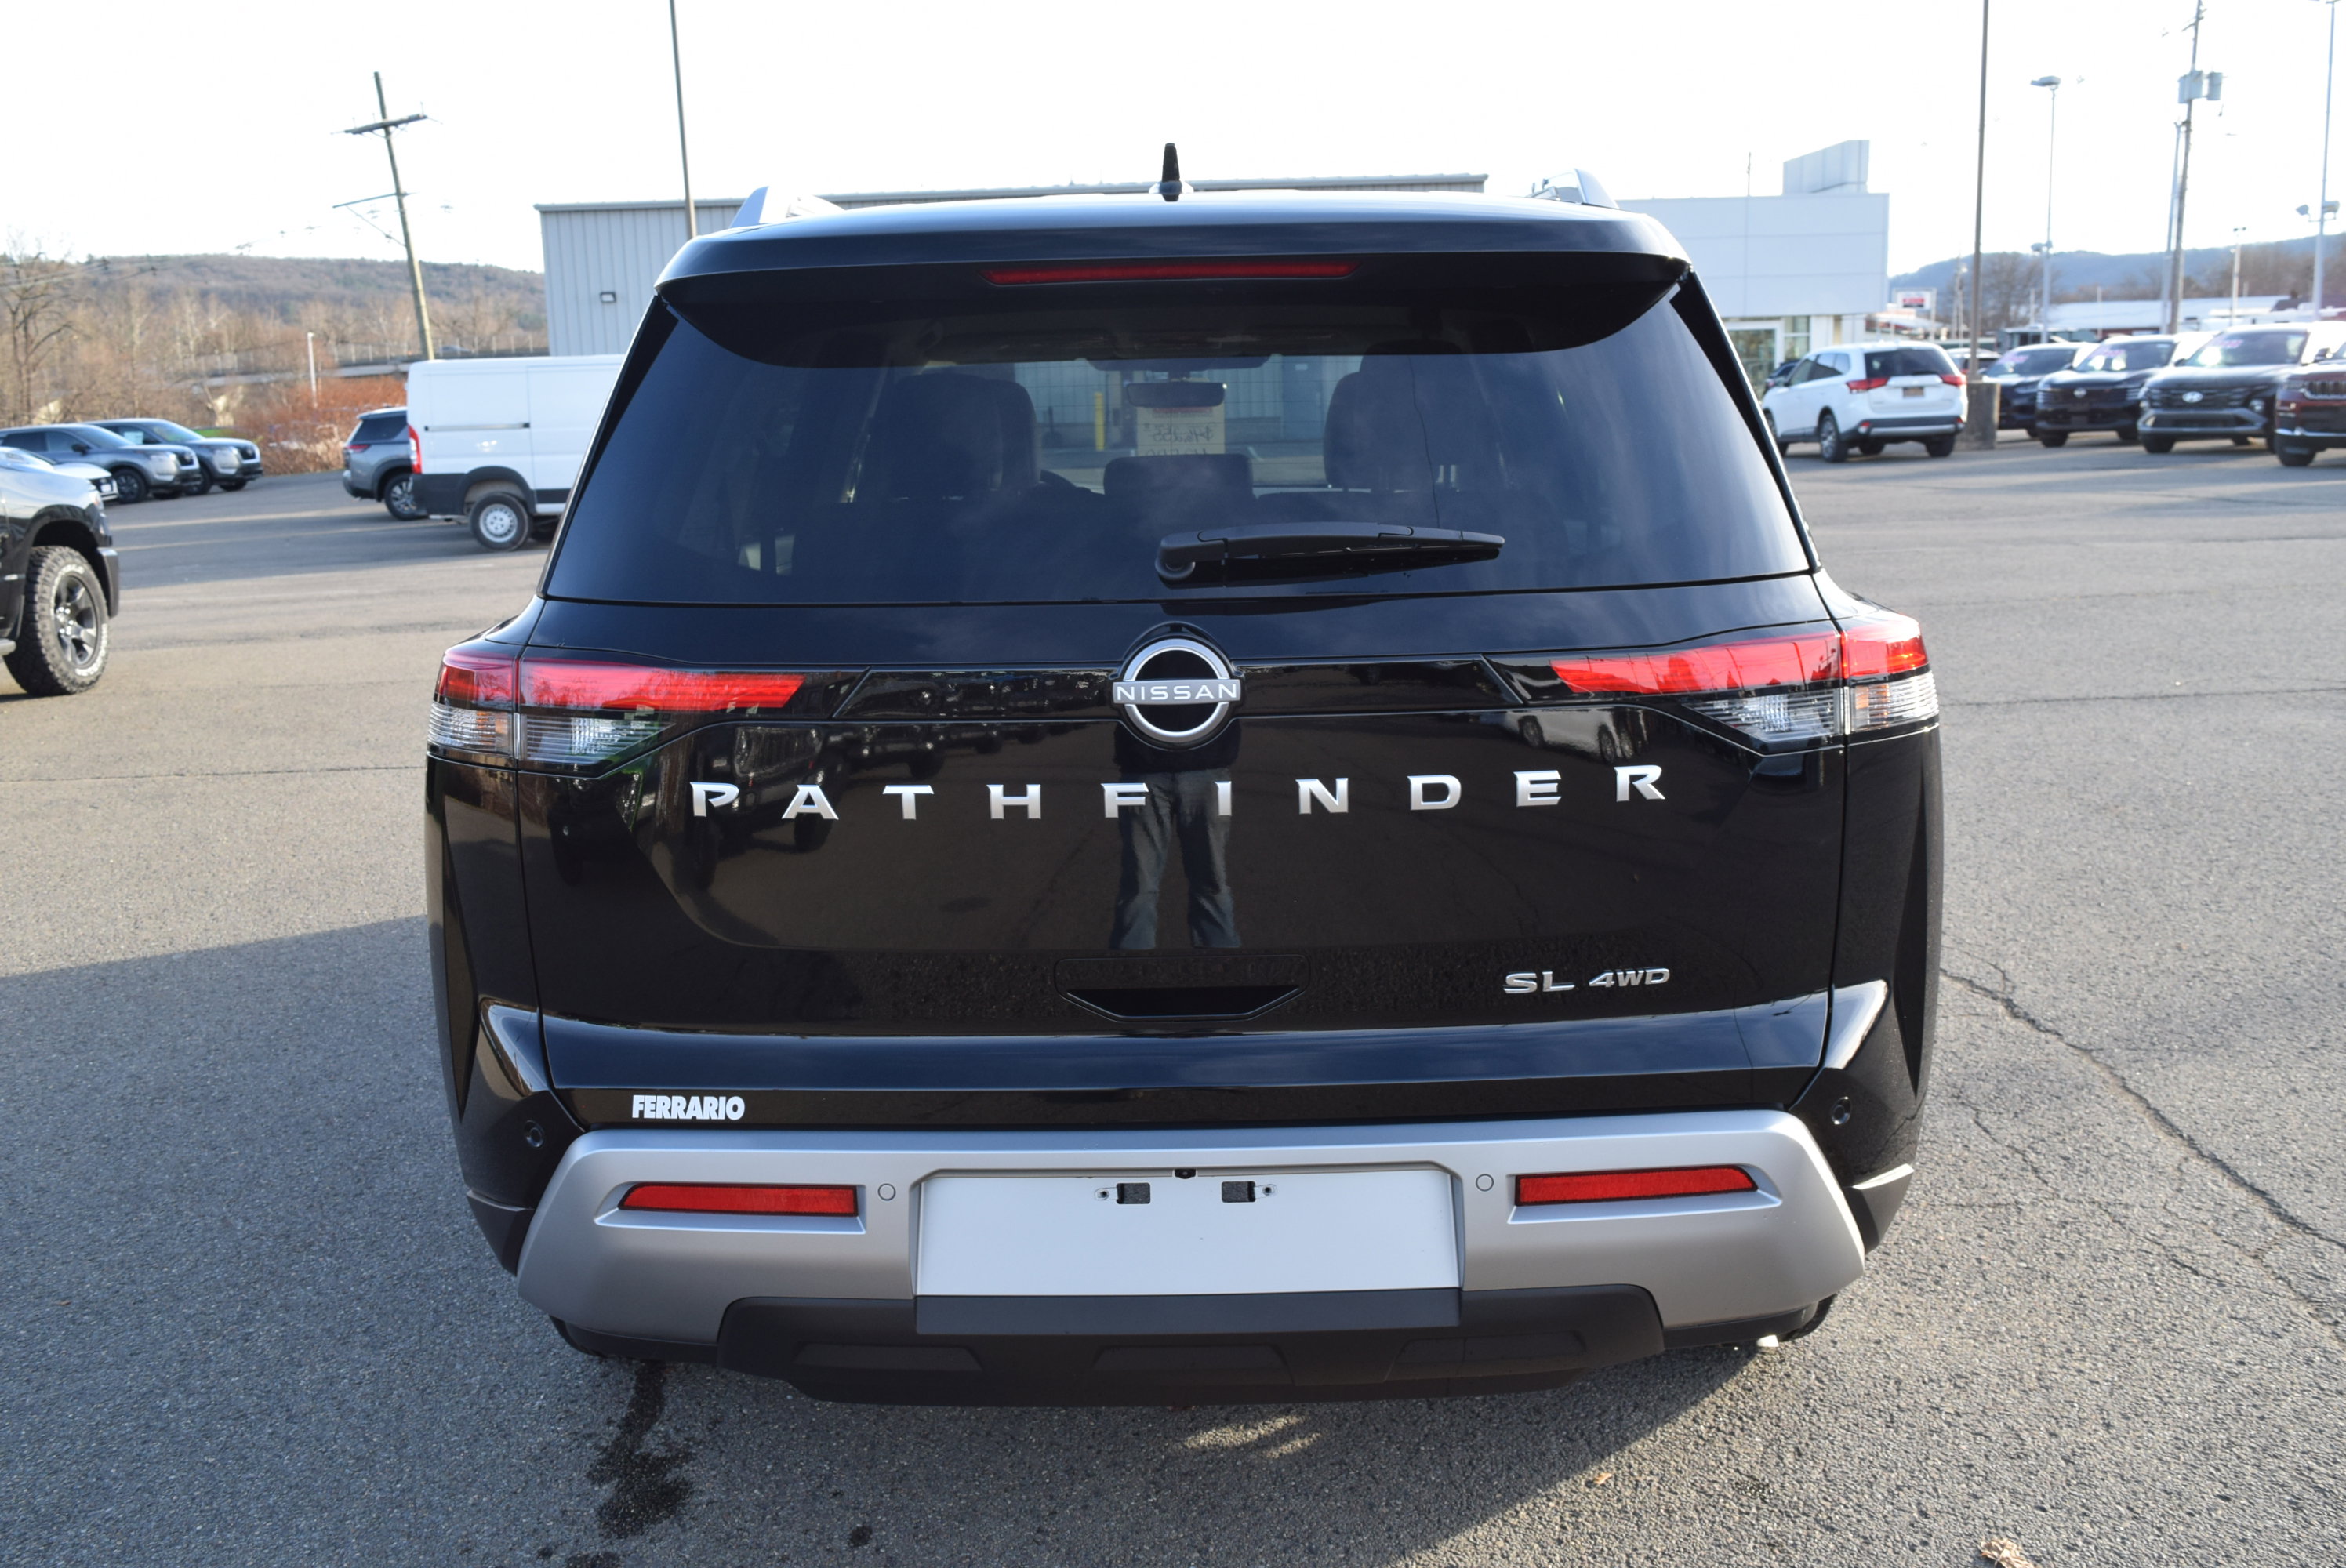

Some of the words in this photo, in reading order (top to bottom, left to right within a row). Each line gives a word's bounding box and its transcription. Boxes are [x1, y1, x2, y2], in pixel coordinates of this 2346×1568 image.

[1117, 684, 1237, 701] NISSAN
[689, 764, 1666, 821] PATHFINDER
[1503, 971, 1575, 994] SL
[1589, 967, 1670, 988] 4WD
[632, 1094, 746, 1121] FERRARIO
